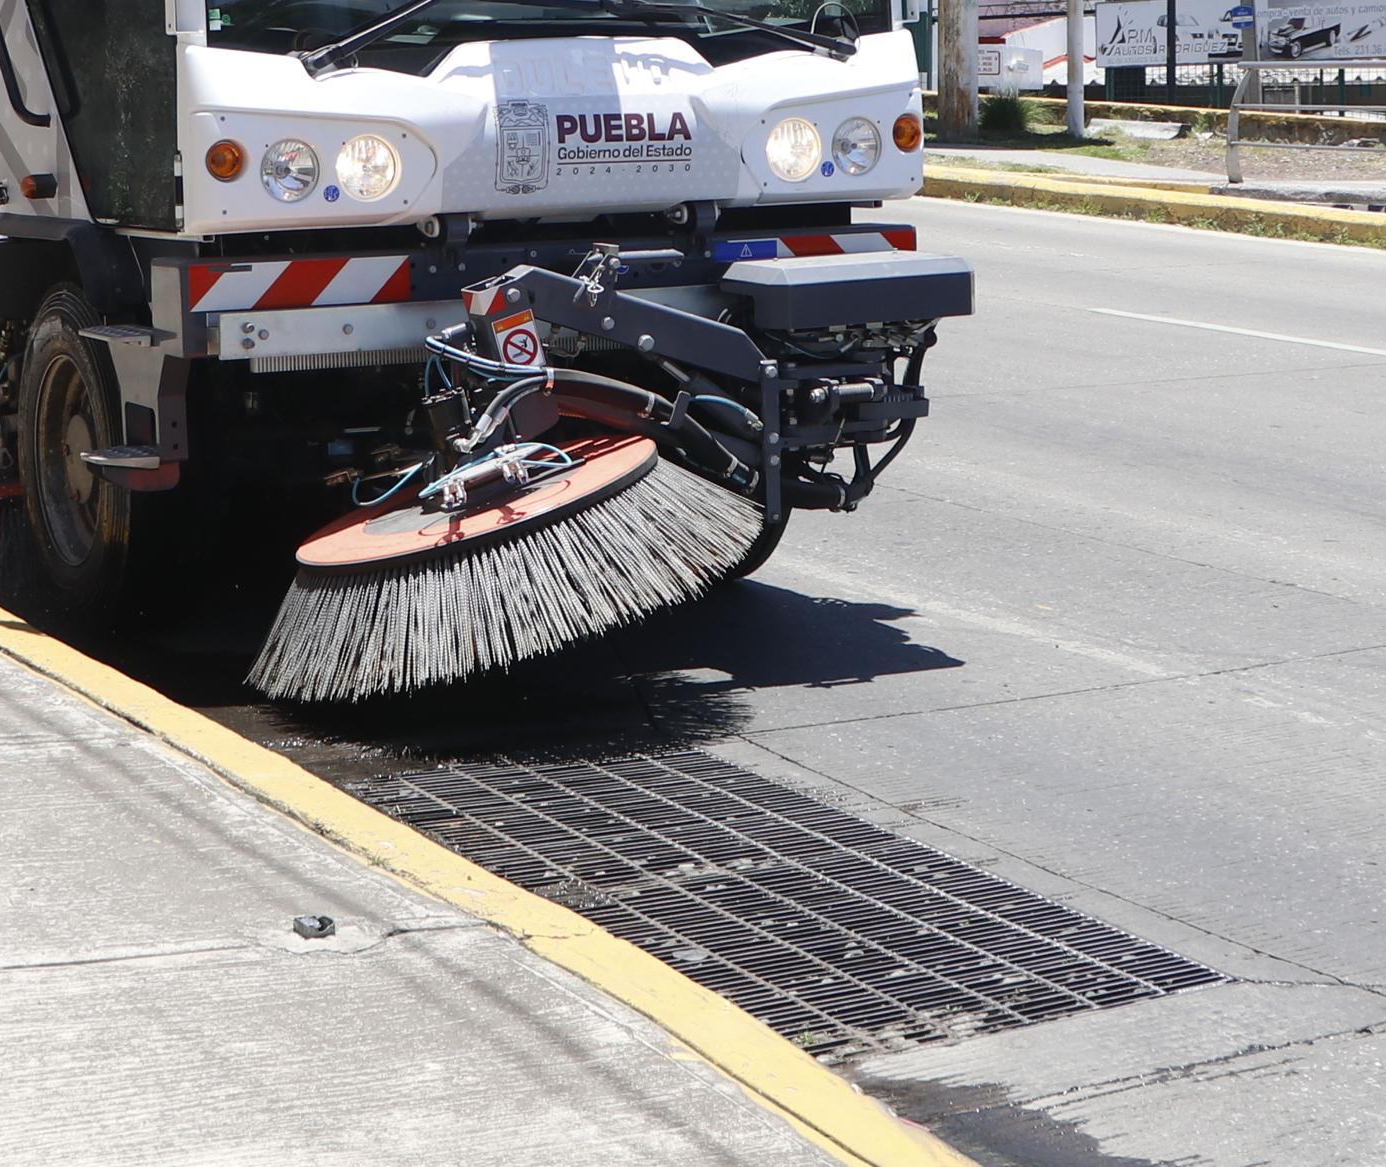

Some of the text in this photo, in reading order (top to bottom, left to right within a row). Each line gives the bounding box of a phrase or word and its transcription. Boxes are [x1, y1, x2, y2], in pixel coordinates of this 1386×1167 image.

[1326, 6, 1349, 16] autos
[555, 112, 692, 144] PUEBLA
[557, 143, 692, 161] Gobierno del Estado
